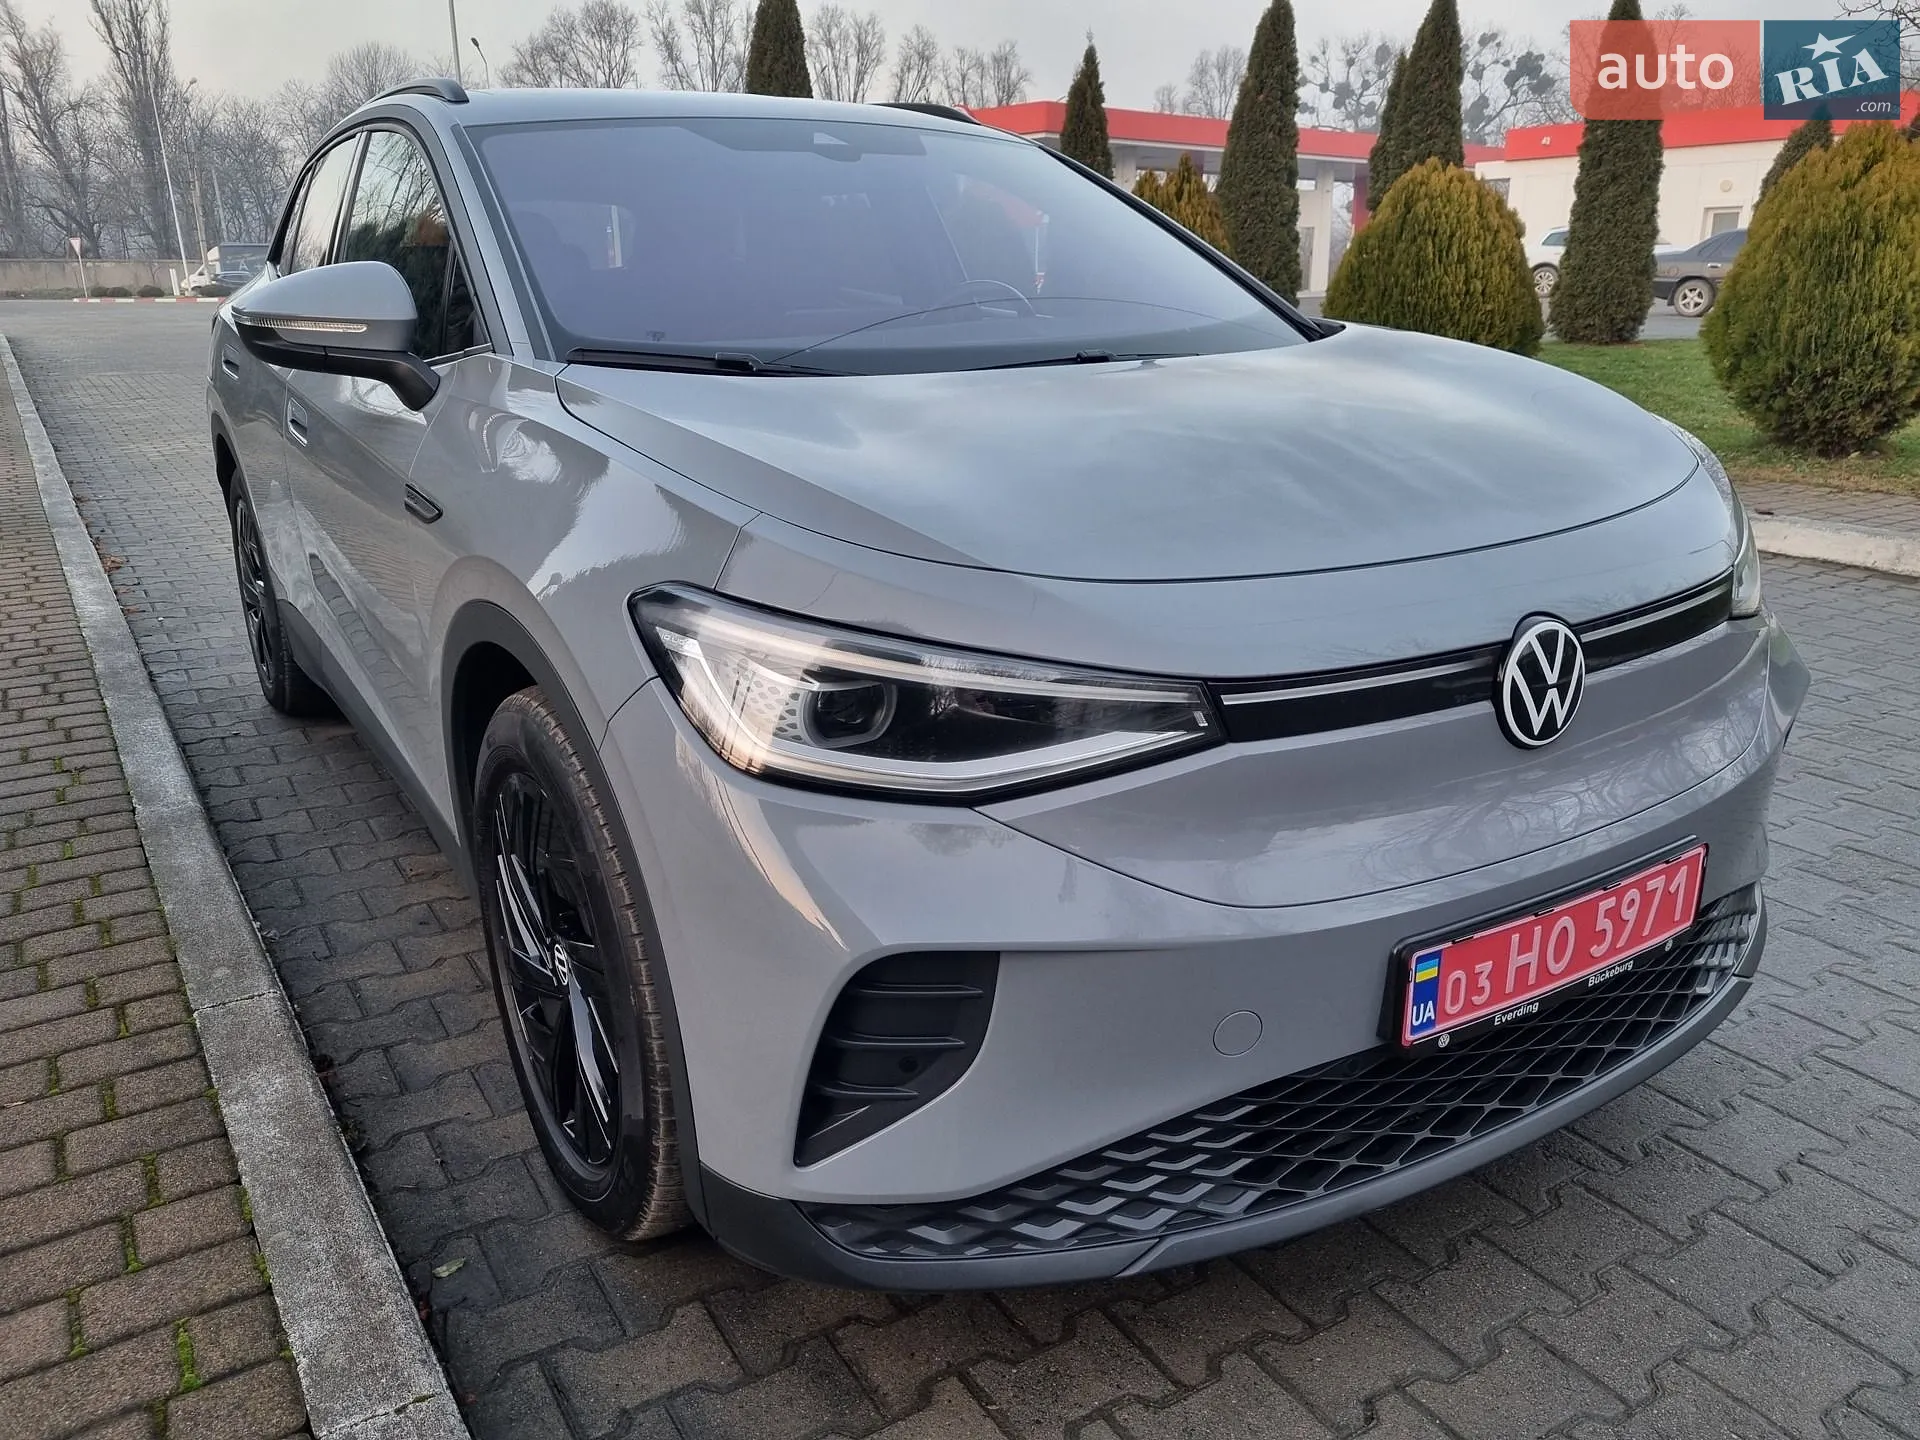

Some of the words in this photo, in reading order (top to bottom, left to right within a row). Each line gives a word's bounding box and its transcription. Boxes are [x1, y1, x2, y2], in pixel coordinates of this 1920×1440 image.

[1444, 959, 1494, 1015] 03
[1505, 916, 1576, 994] HO
[1589, 865, 1689, 958] 5971
[1411, 1001, 1435, 1026] UA
[1494, 1002, 1539, 1026] Everding
[1588, 960, 1634, 988] Bückeburg
